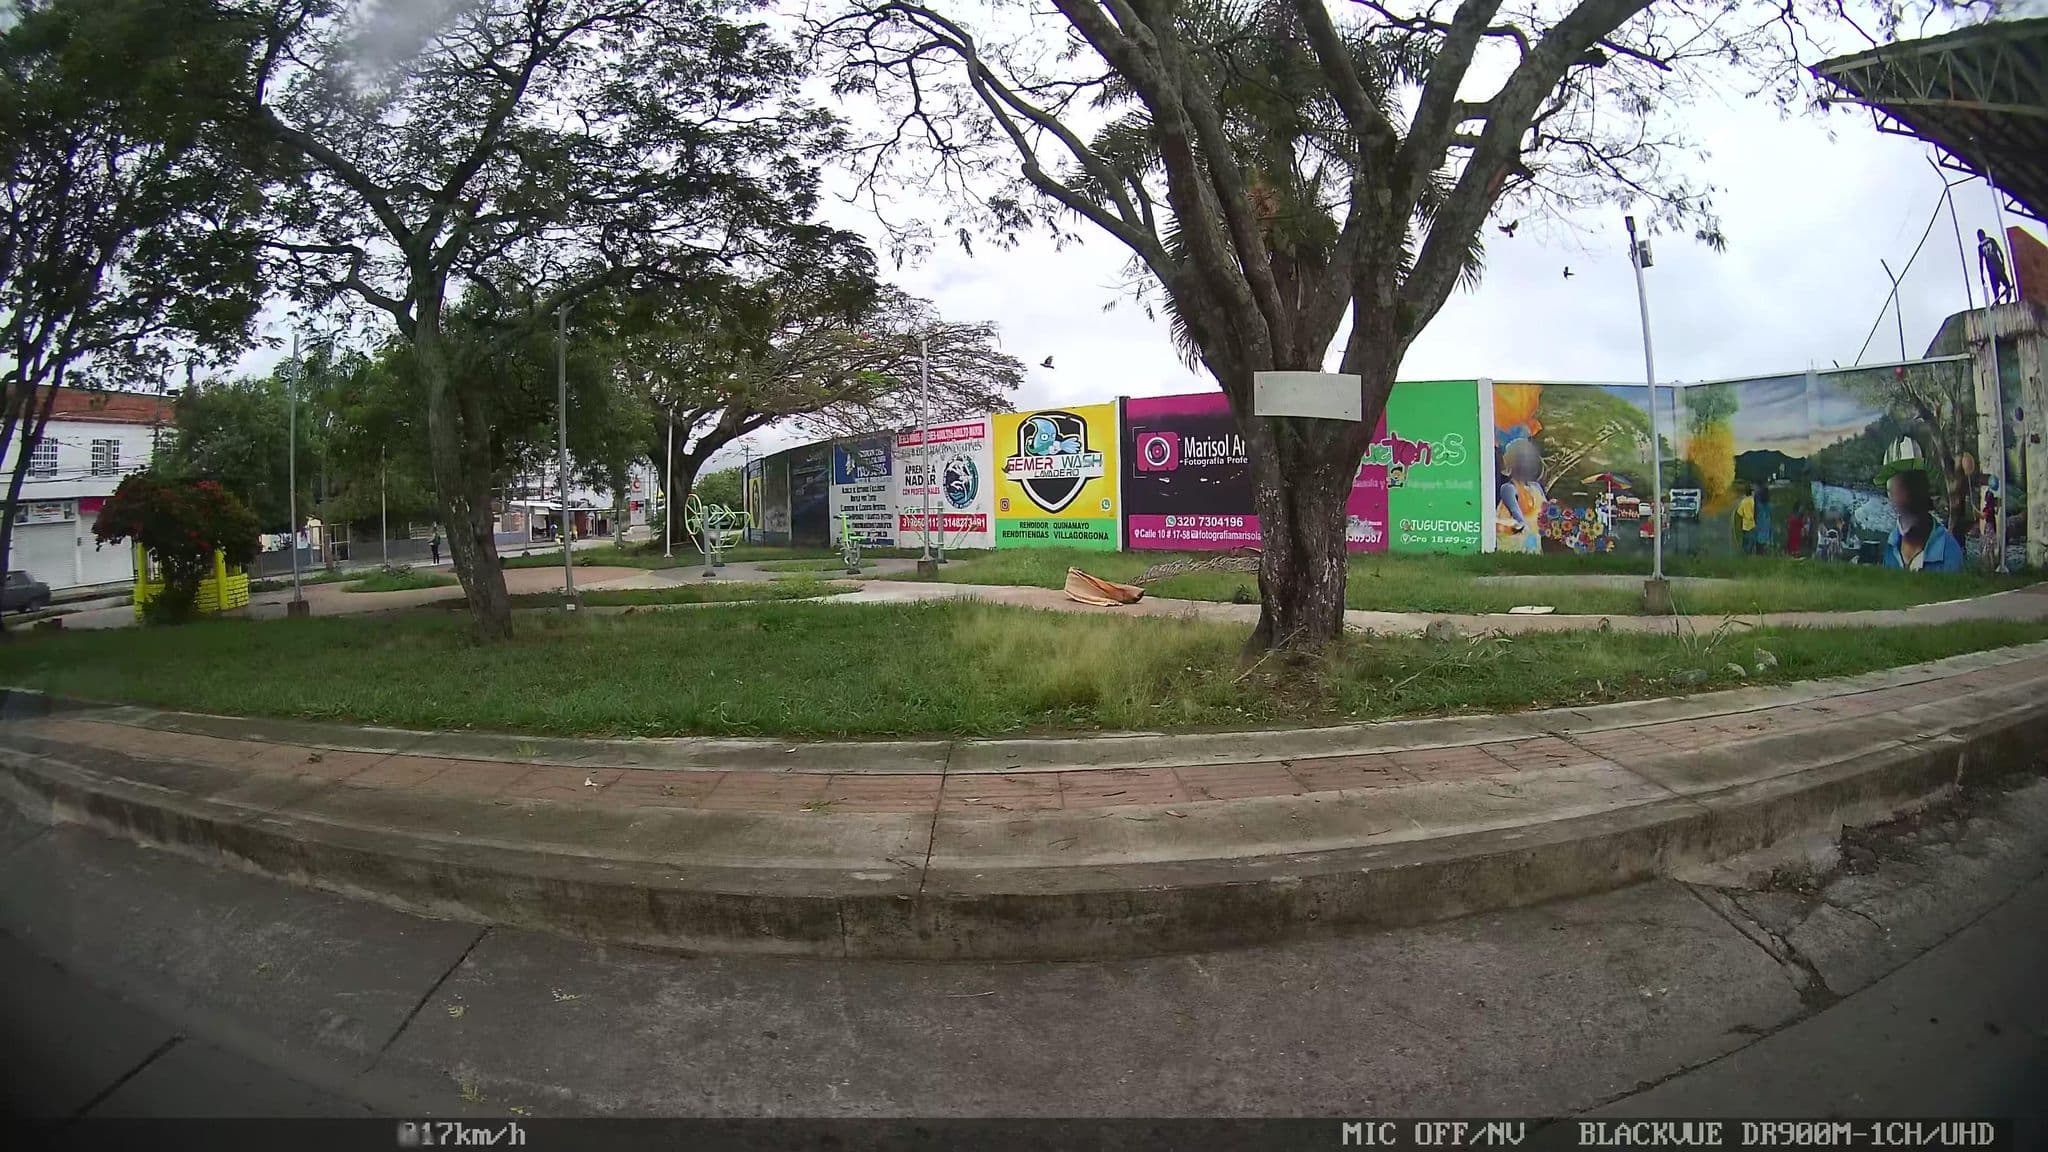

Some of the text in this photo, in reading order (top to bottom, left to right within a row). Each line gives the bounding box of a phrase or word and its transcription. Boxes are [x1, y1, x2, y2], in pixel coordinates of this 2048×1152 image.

[1184, 433, 1229, 458] Marisol
[1061, 454, 1102, 468] WASH
[905, 464, 930, 475] APRENE
[1034, 468, 1079, 477] LAVADERO
[1053, 522, 1089, 530] QUINAMAYO
[1176, 517, 1243, 527] 320 7304196
[1410, 519, 1480, 533] JUGUETONES
[1002, 530, 1109, 540] RENDITIENDAS VILLAGORGONA
[1140, 529, 1156, 538] Calle
[1158, 530, 1166, 539] 10
